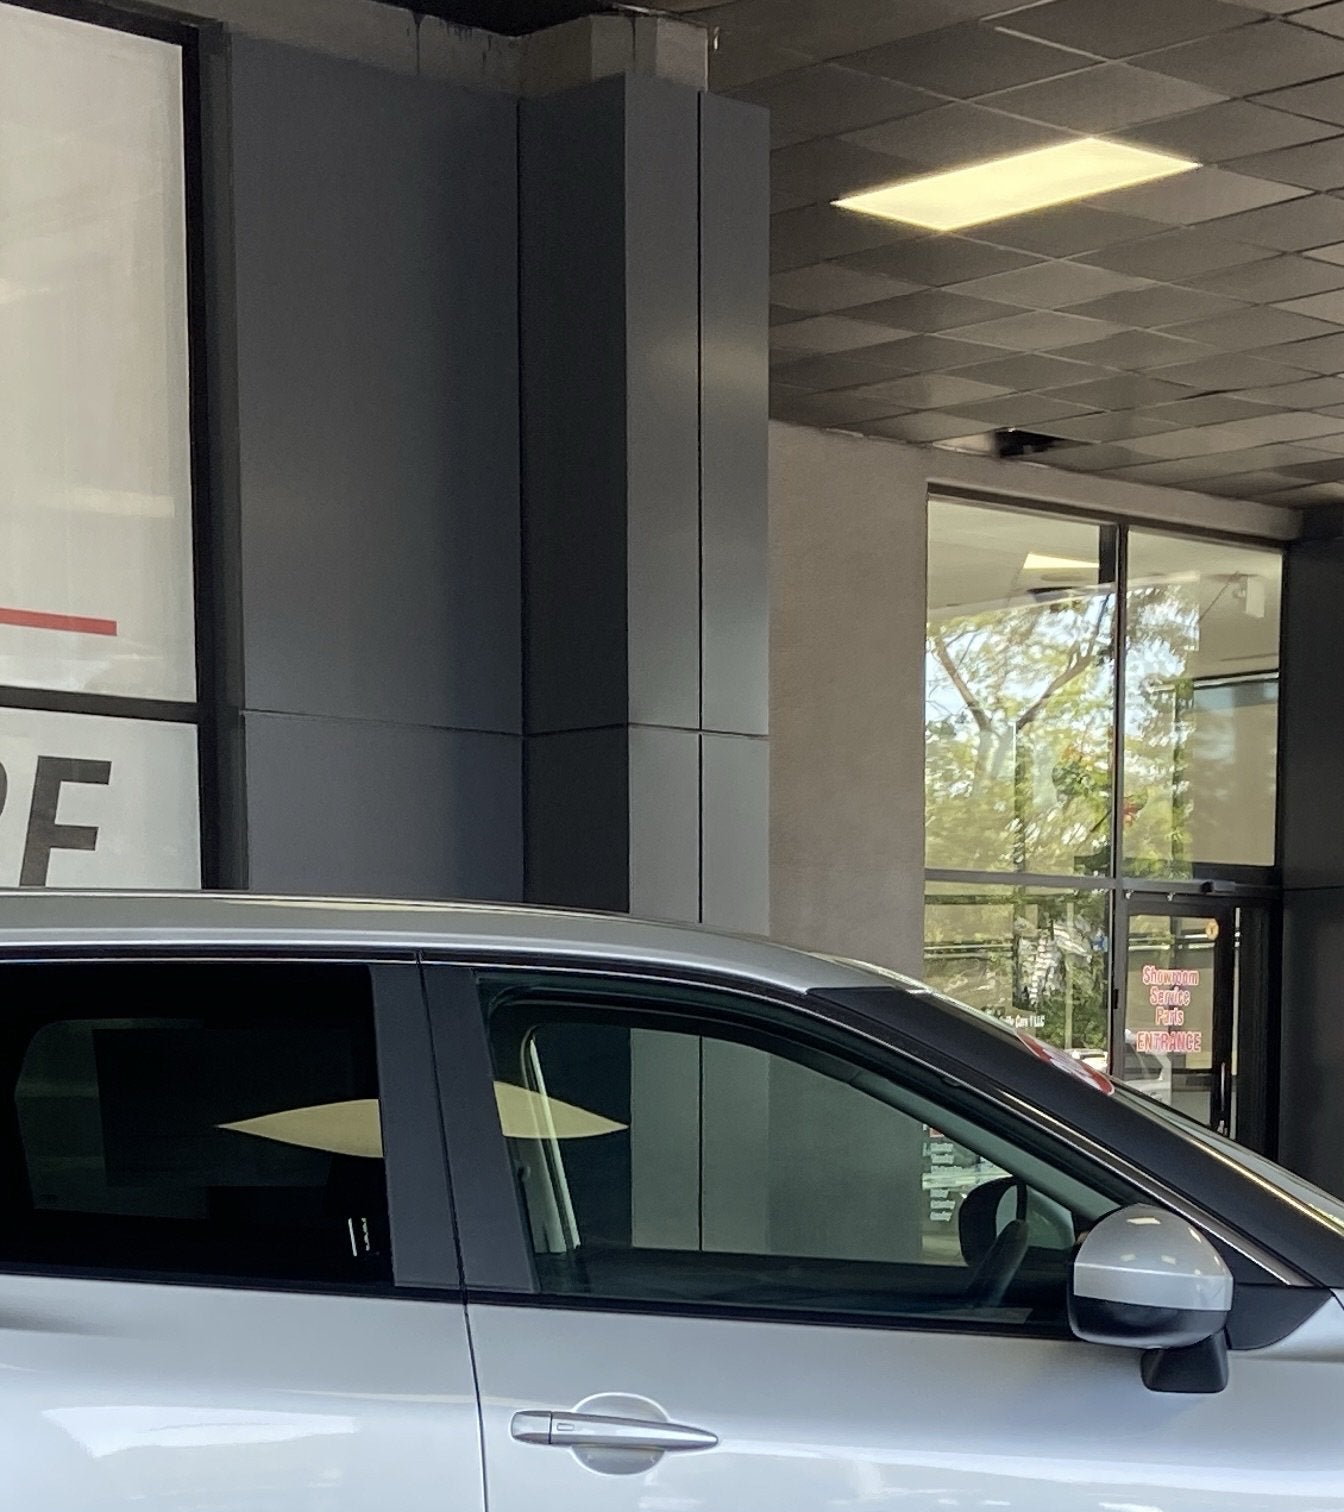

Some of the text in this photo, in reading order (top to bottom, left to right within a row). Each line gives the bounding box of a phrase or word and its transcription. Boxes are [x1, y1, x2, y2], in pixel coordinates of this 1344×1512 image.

[1142, 965, 1200, 986] Showroom
[1149, 986, 1191, 1006] Service
[1155, 1006, 1185, 1026] Parts
[1136, 1031, 1202, 1053] ENTRANCE
